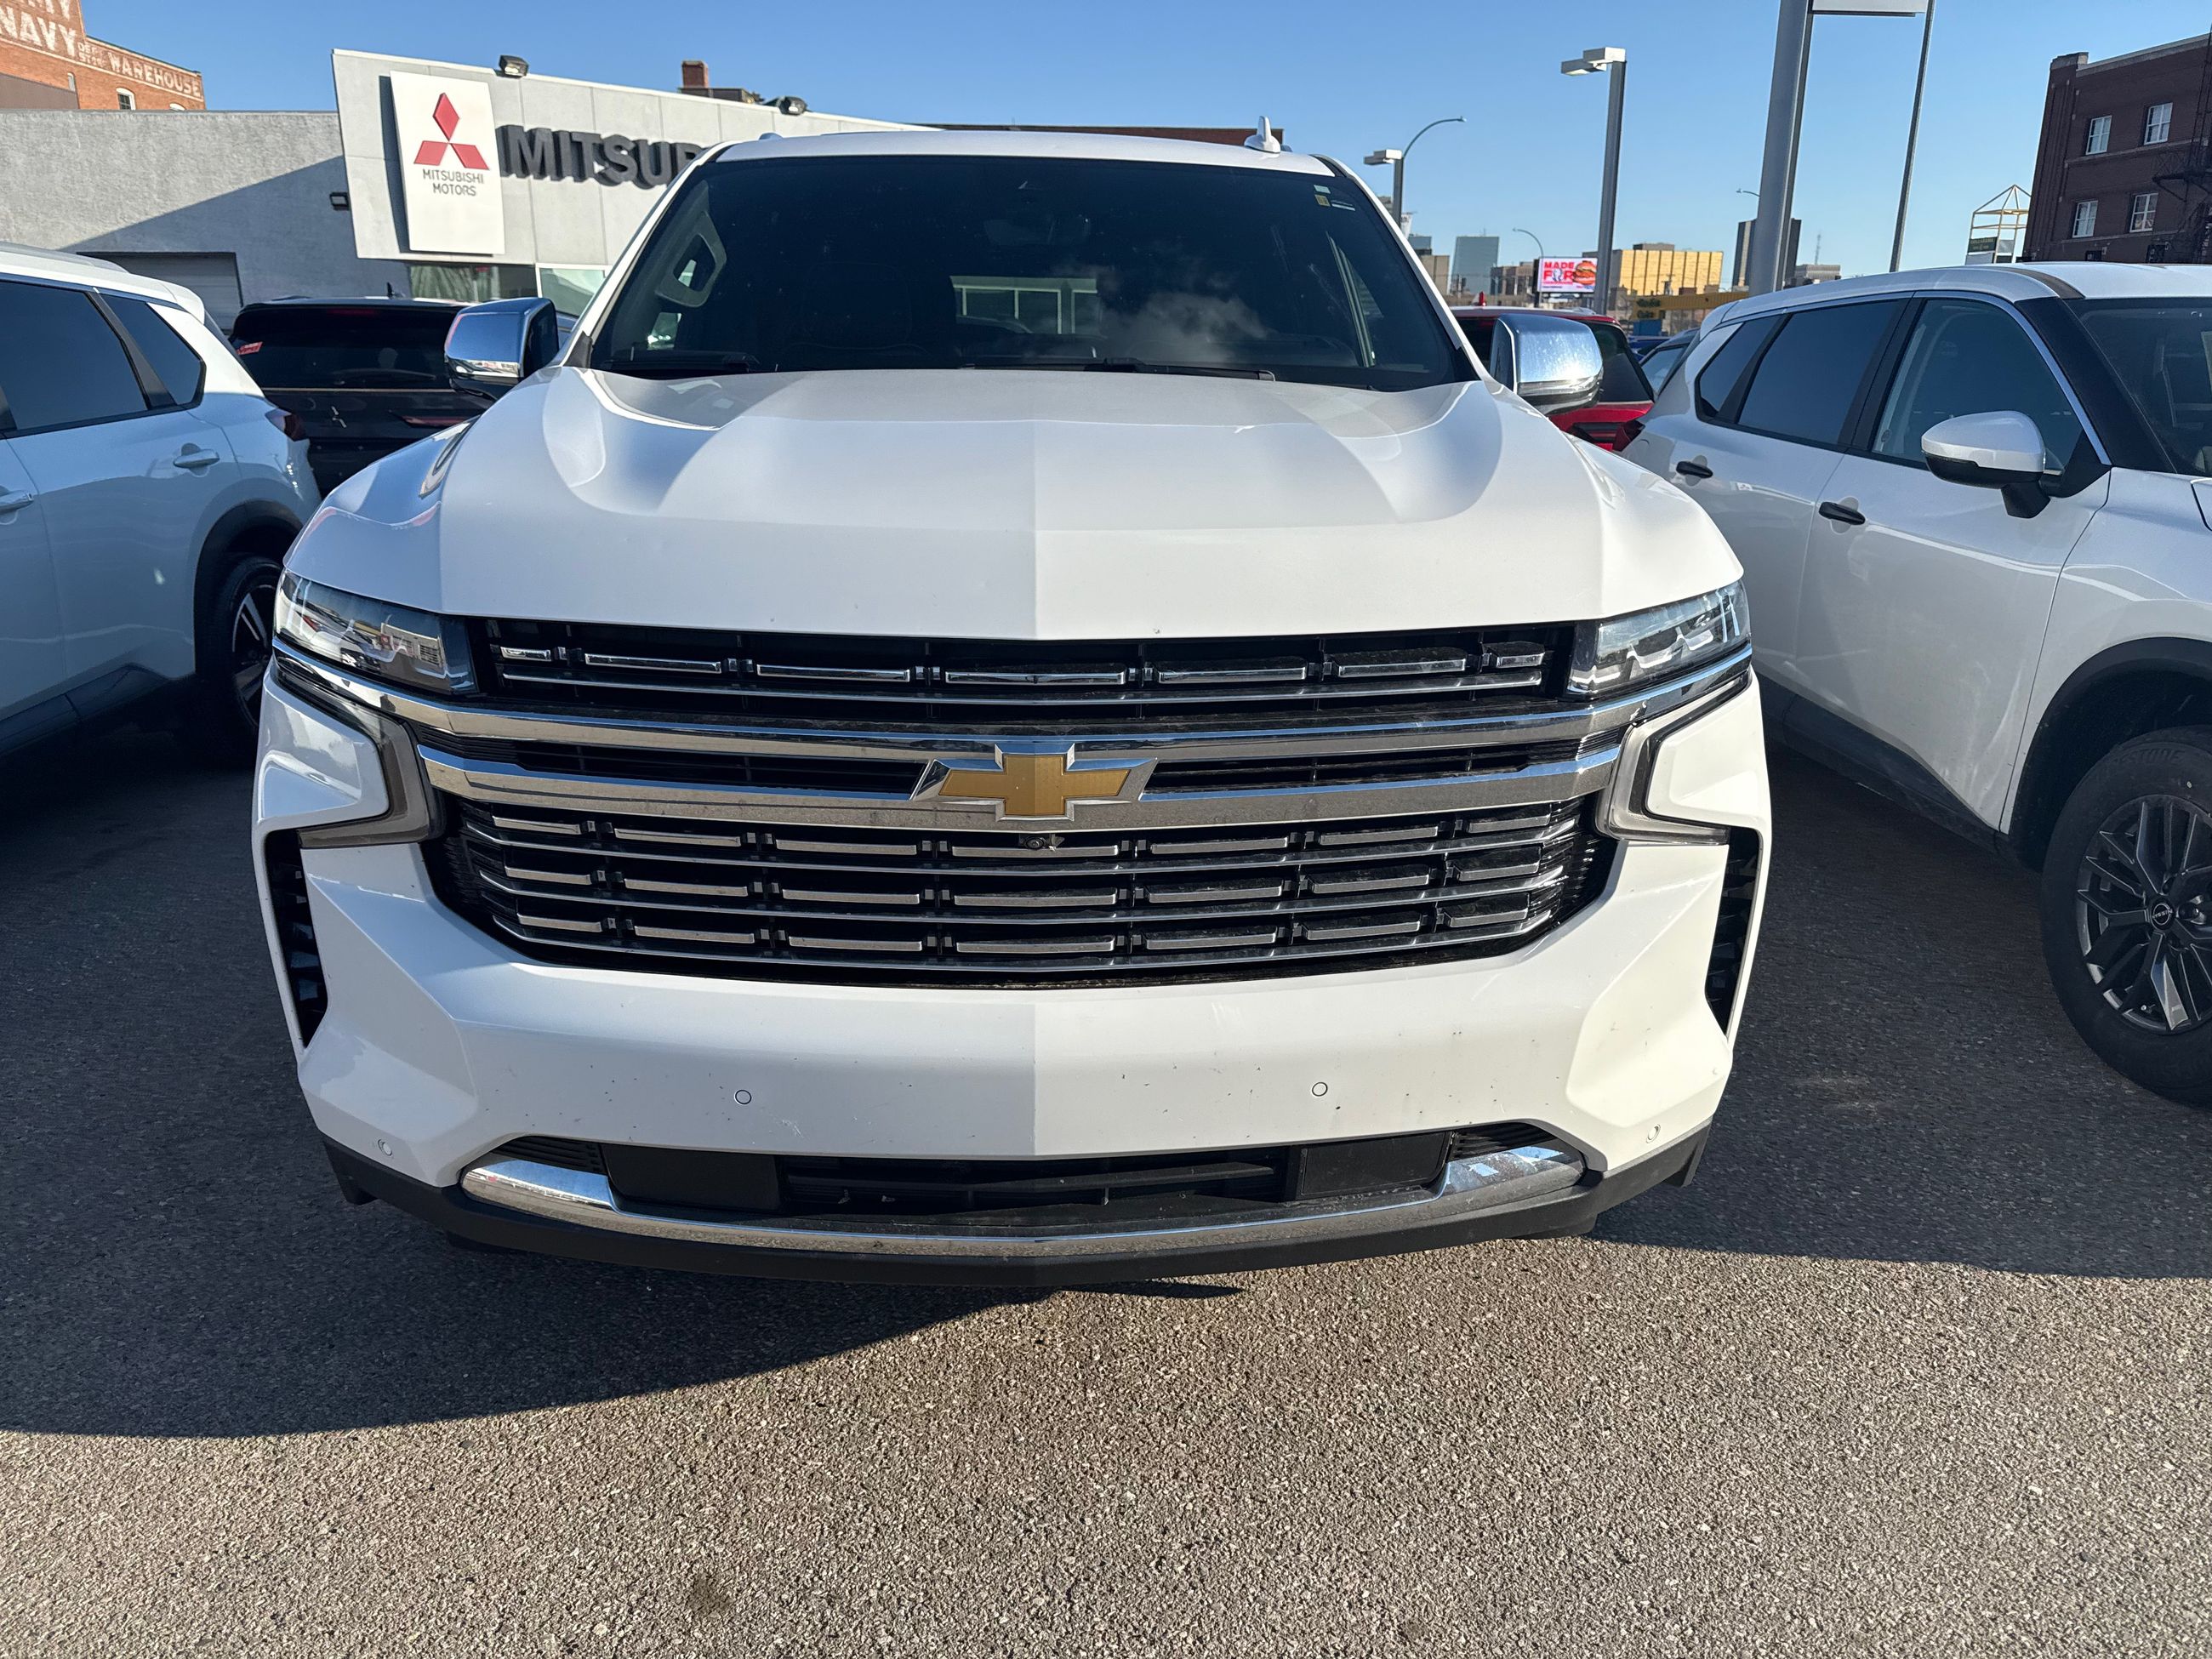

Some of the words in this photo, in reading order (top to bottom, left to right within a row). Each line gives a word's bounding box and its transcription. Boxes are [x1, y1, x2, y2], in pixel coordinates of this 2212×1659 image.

[0, 6, 77, 57] NAVY
[107, 52, 201, 98] WAREHOUSE
[422, 168, 484, 185] MITSUBISHI
[432, 183, 476, 197] MOTORS
